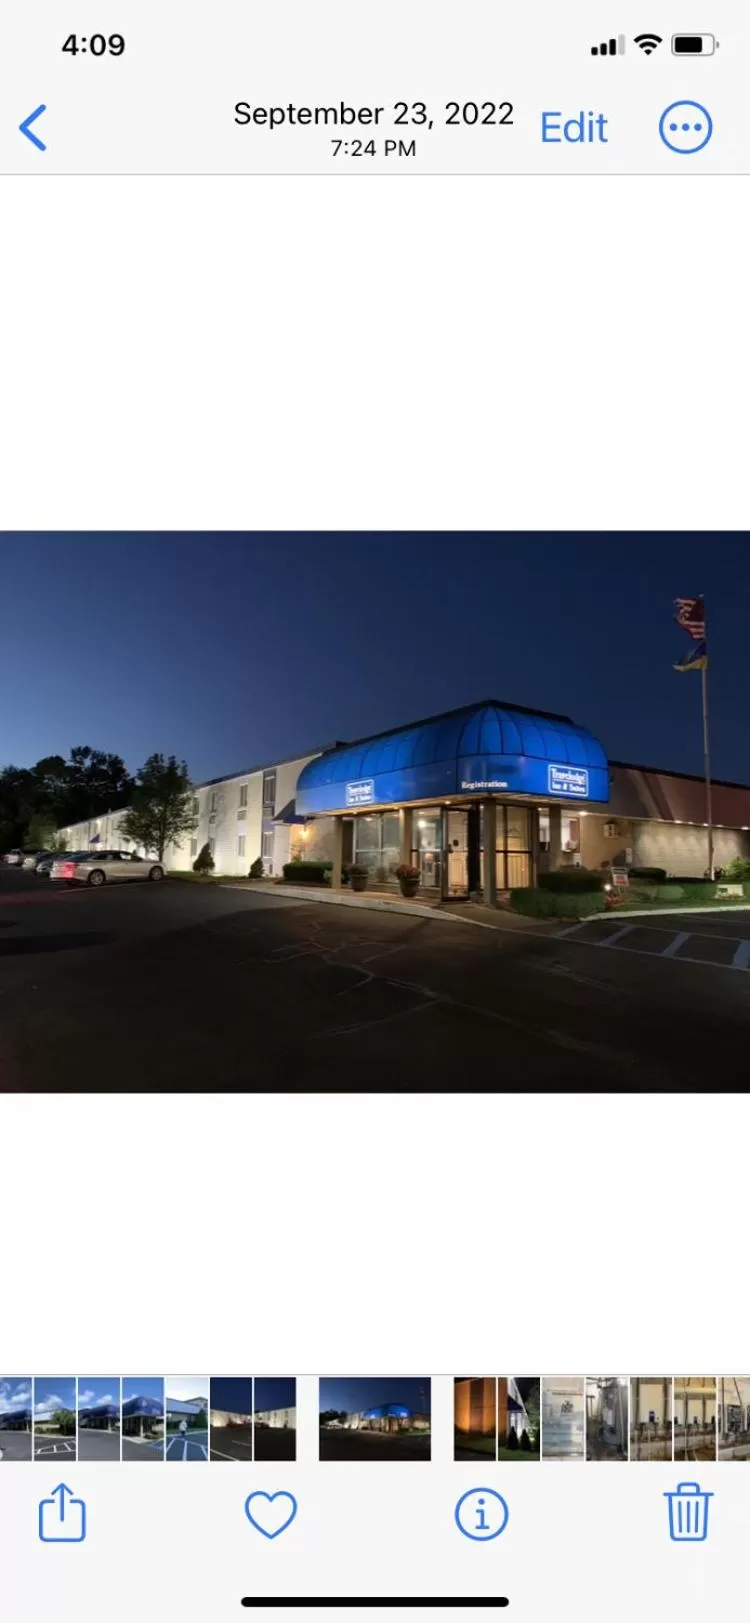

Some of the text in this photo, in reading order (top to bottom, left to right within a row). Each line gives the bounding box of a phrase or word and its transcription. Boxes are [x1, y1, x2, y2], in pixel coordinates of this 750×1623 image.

[61, 33, 126, 57] 4:09
[234, 101, 514, 130] September 23, 2022
[541, 110, 609, 143] Edit
[330, 139, 416, 157] 7:24 PM
[461, 780, 508, 789] Registration
